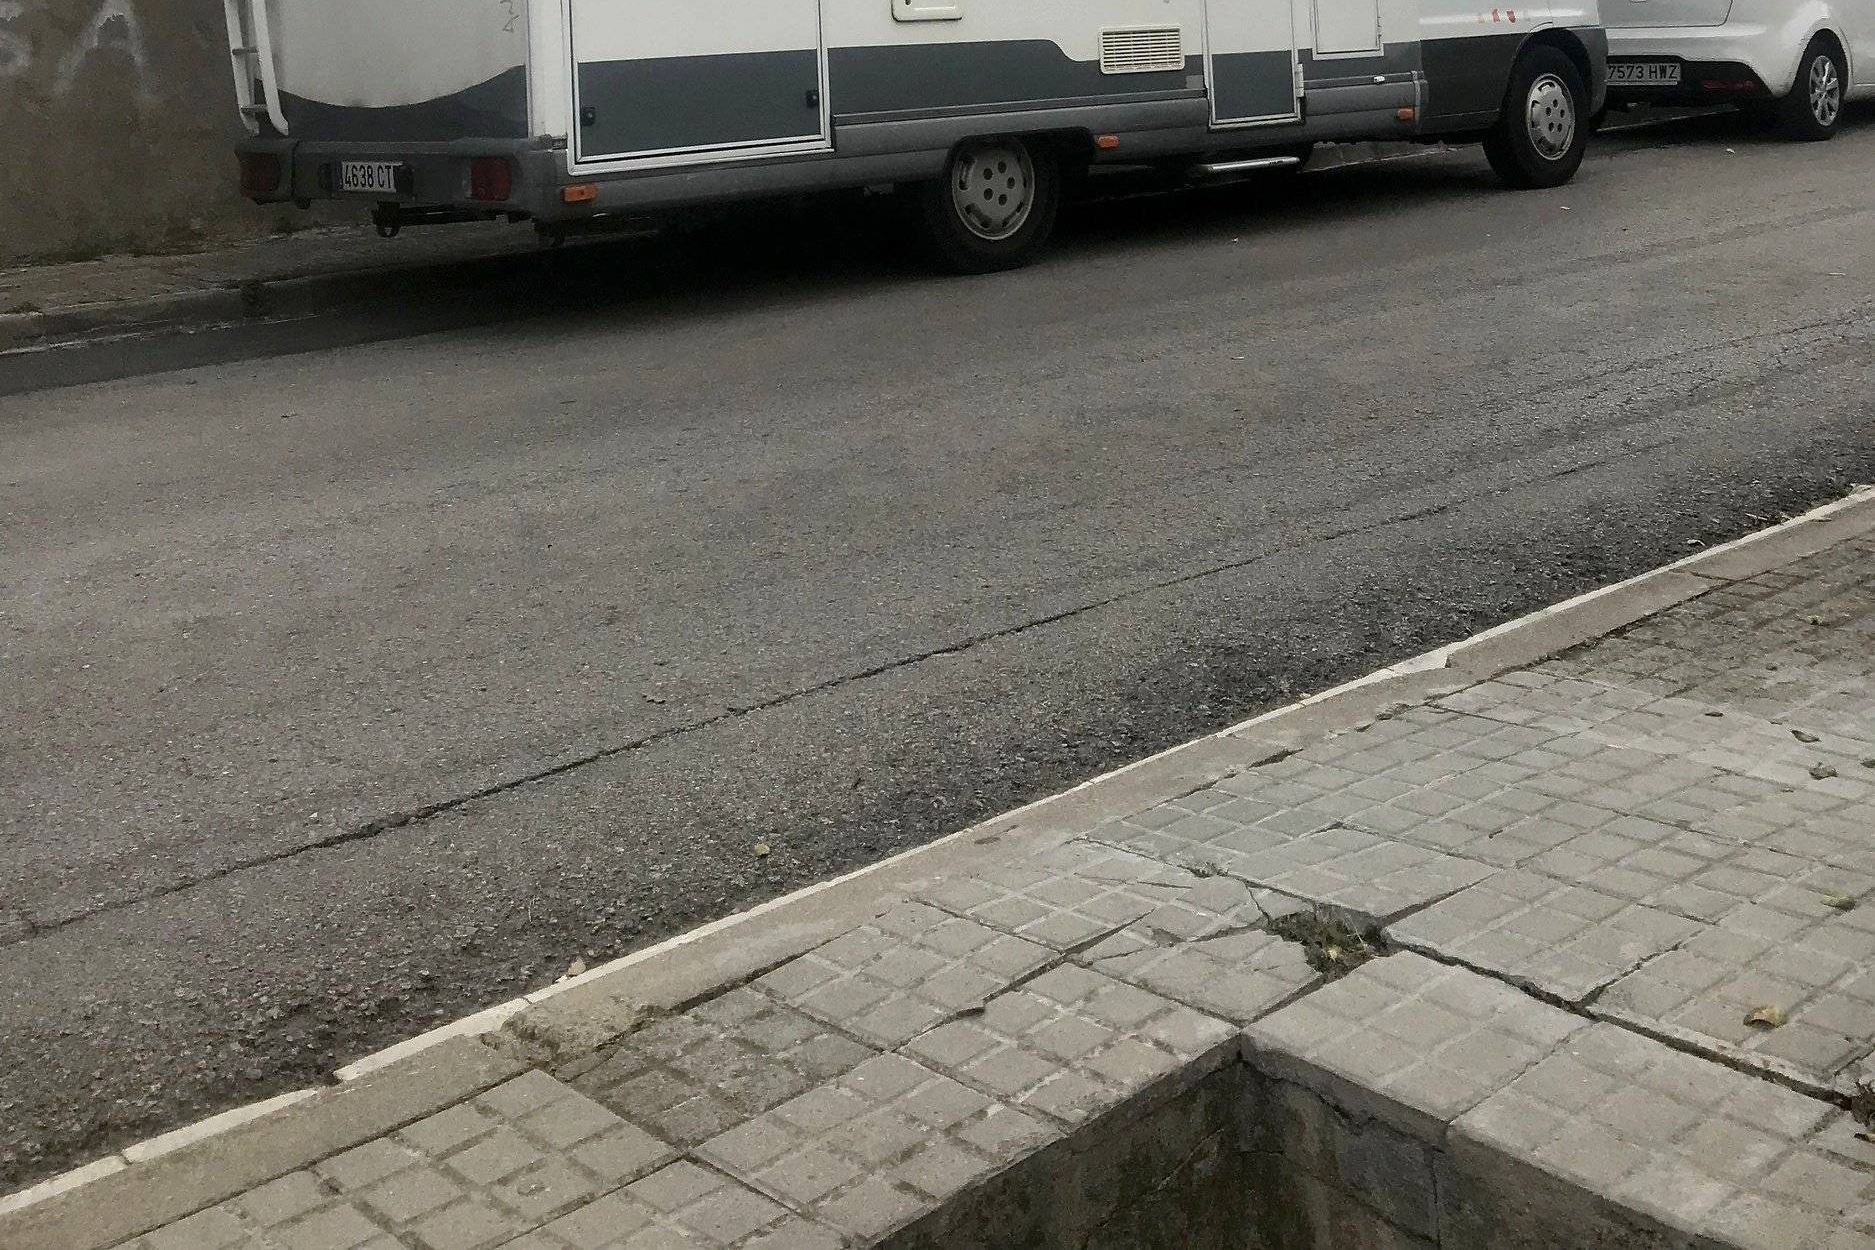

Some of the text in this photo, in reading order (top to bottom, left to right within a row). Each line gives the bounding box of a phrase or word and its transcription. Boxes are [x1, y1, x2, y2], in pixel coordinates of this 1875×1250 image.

[1608, 65, 1677, 79] 7573 HWZ
[344, 164, 394, 189] 4638 CT
